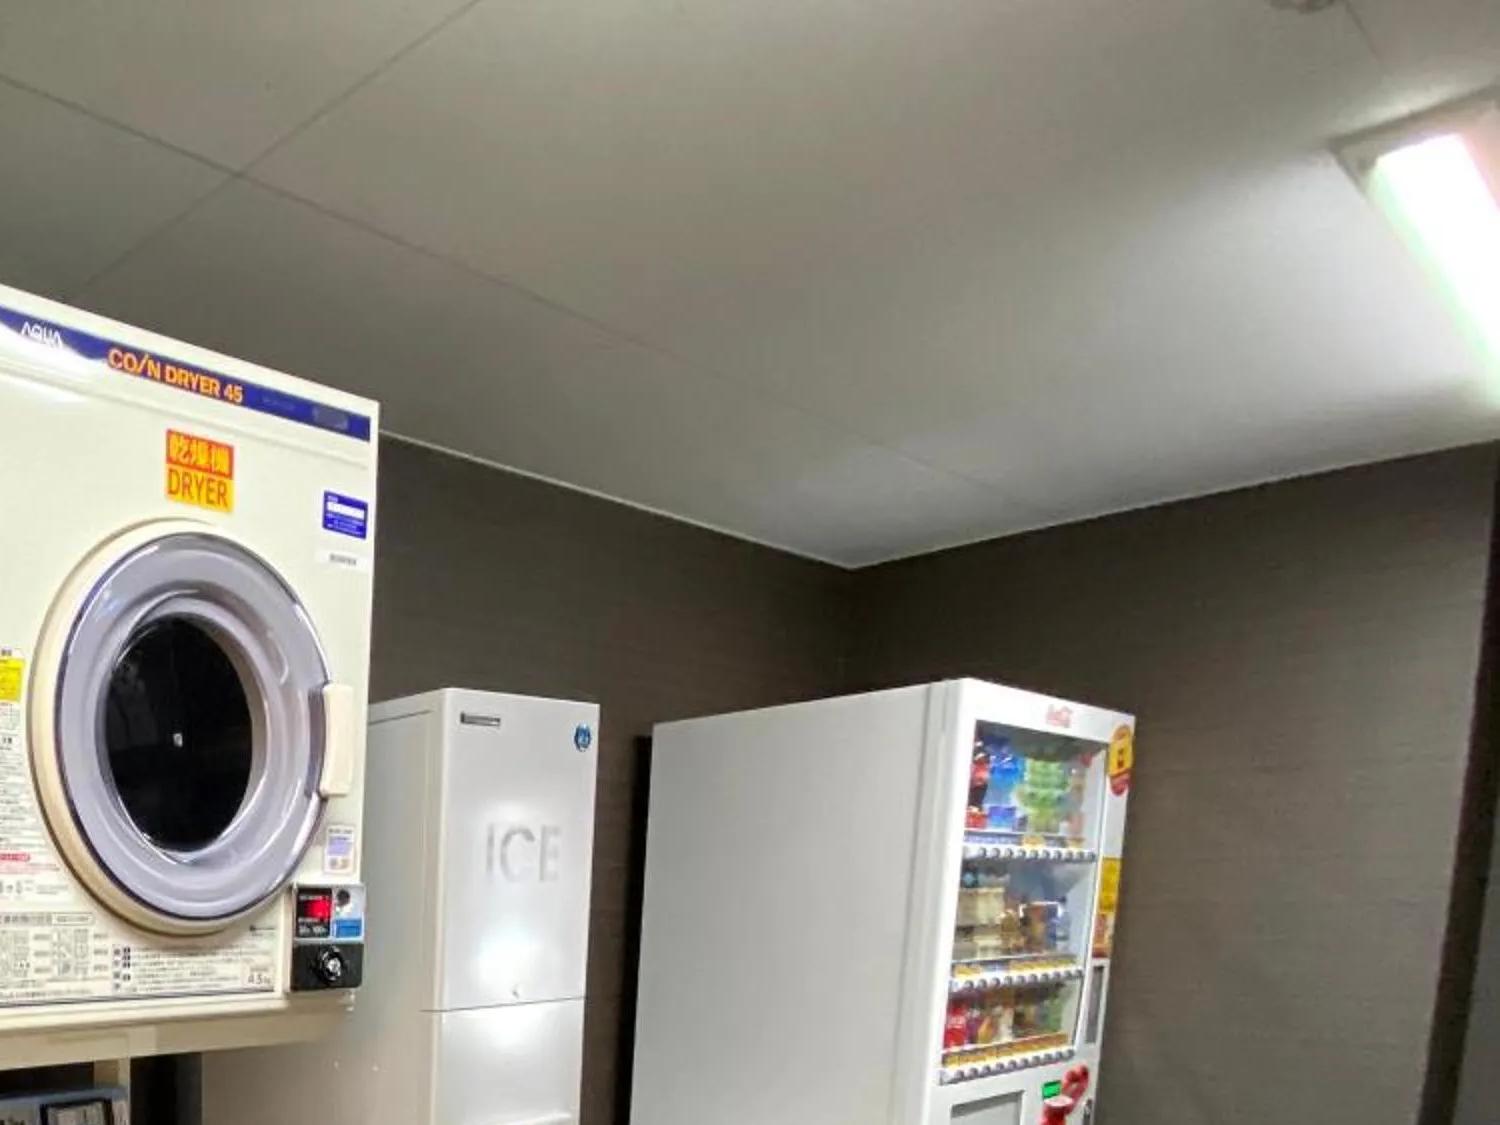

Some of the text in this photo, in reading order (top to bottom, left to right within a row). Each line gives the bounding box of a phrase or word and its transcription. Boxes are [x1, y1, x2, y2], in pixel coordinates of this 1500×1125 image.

[165, 365, 220, 398] DRYER
[223, 384, 243, 403] 45
[168, 467, 229, 508] DRYER
[486, 822, 562, 884] ICE
